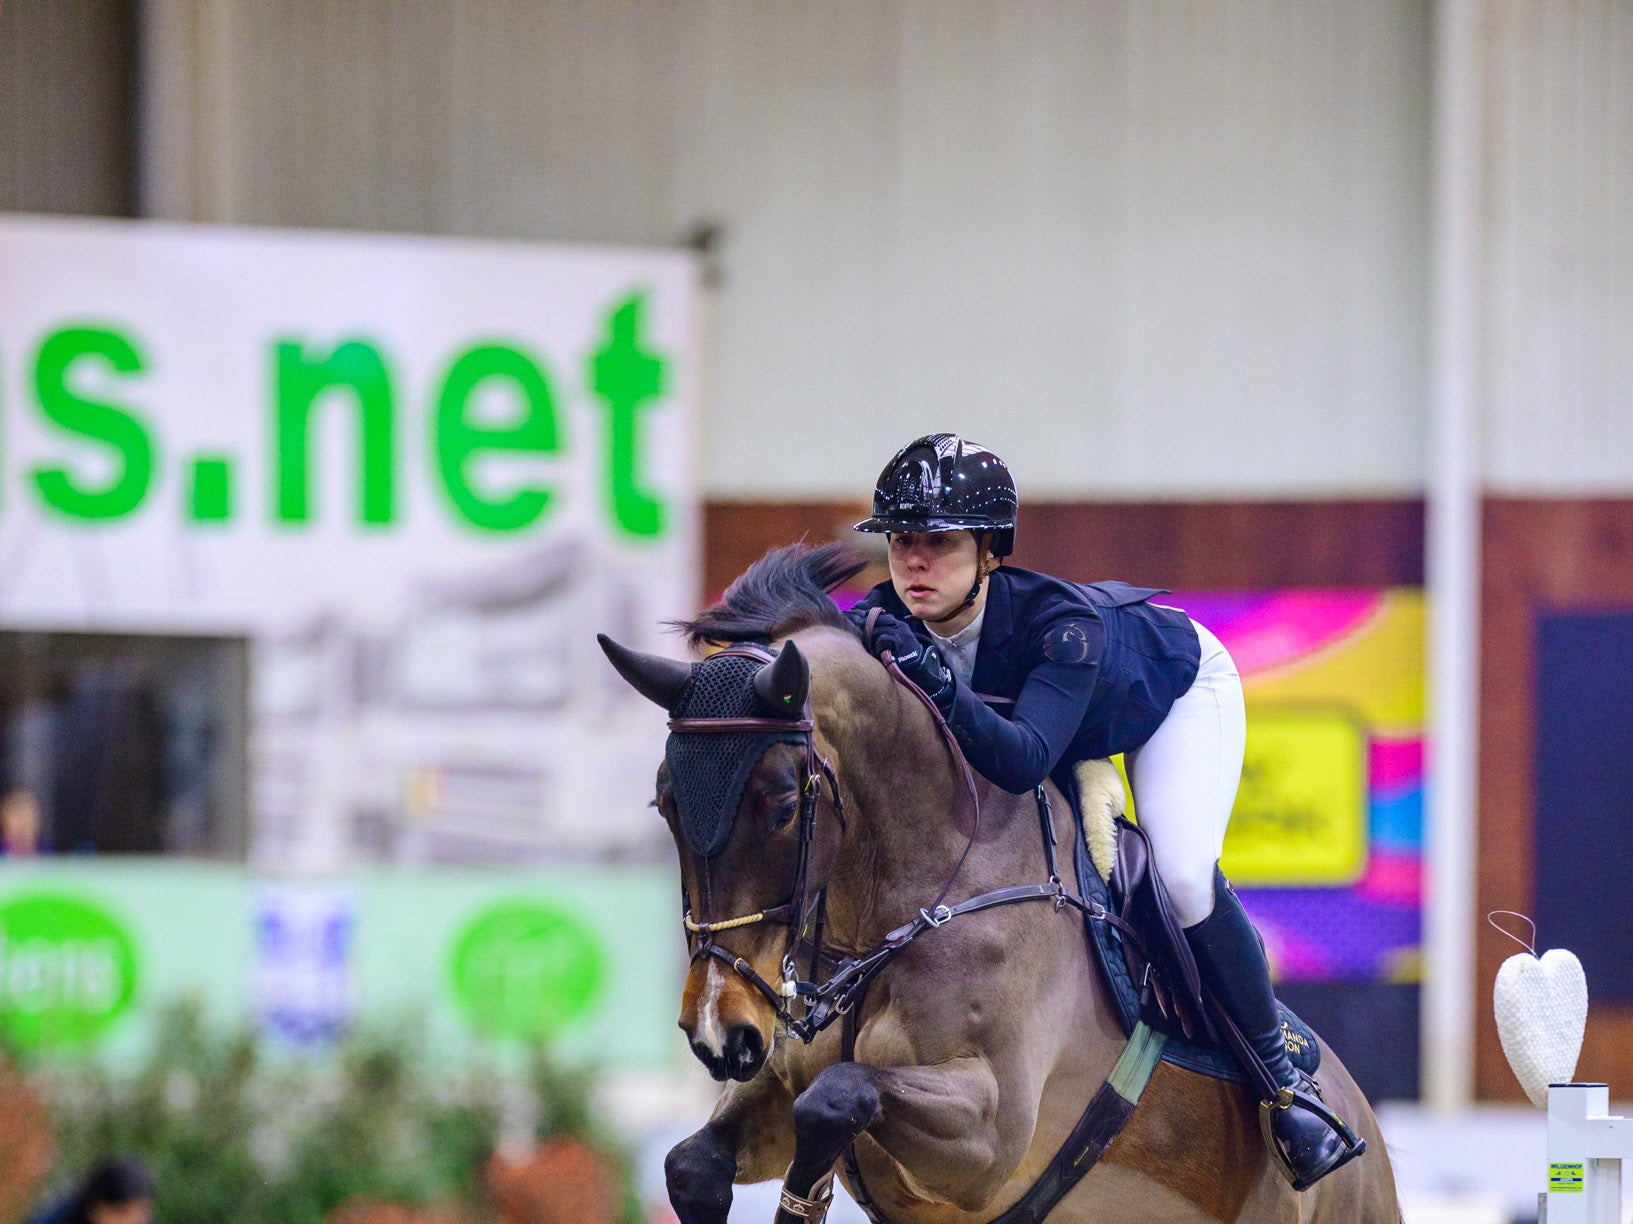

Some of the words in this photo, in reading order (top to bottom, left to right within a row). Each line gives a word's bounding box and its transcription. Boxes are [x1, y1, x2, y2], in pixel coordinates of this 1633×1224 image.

[0, 289, 669, 540] s.net
[1283, 1029, 1309, 1049] MANDA
[1284, 1040, 1301, 1055] SON
